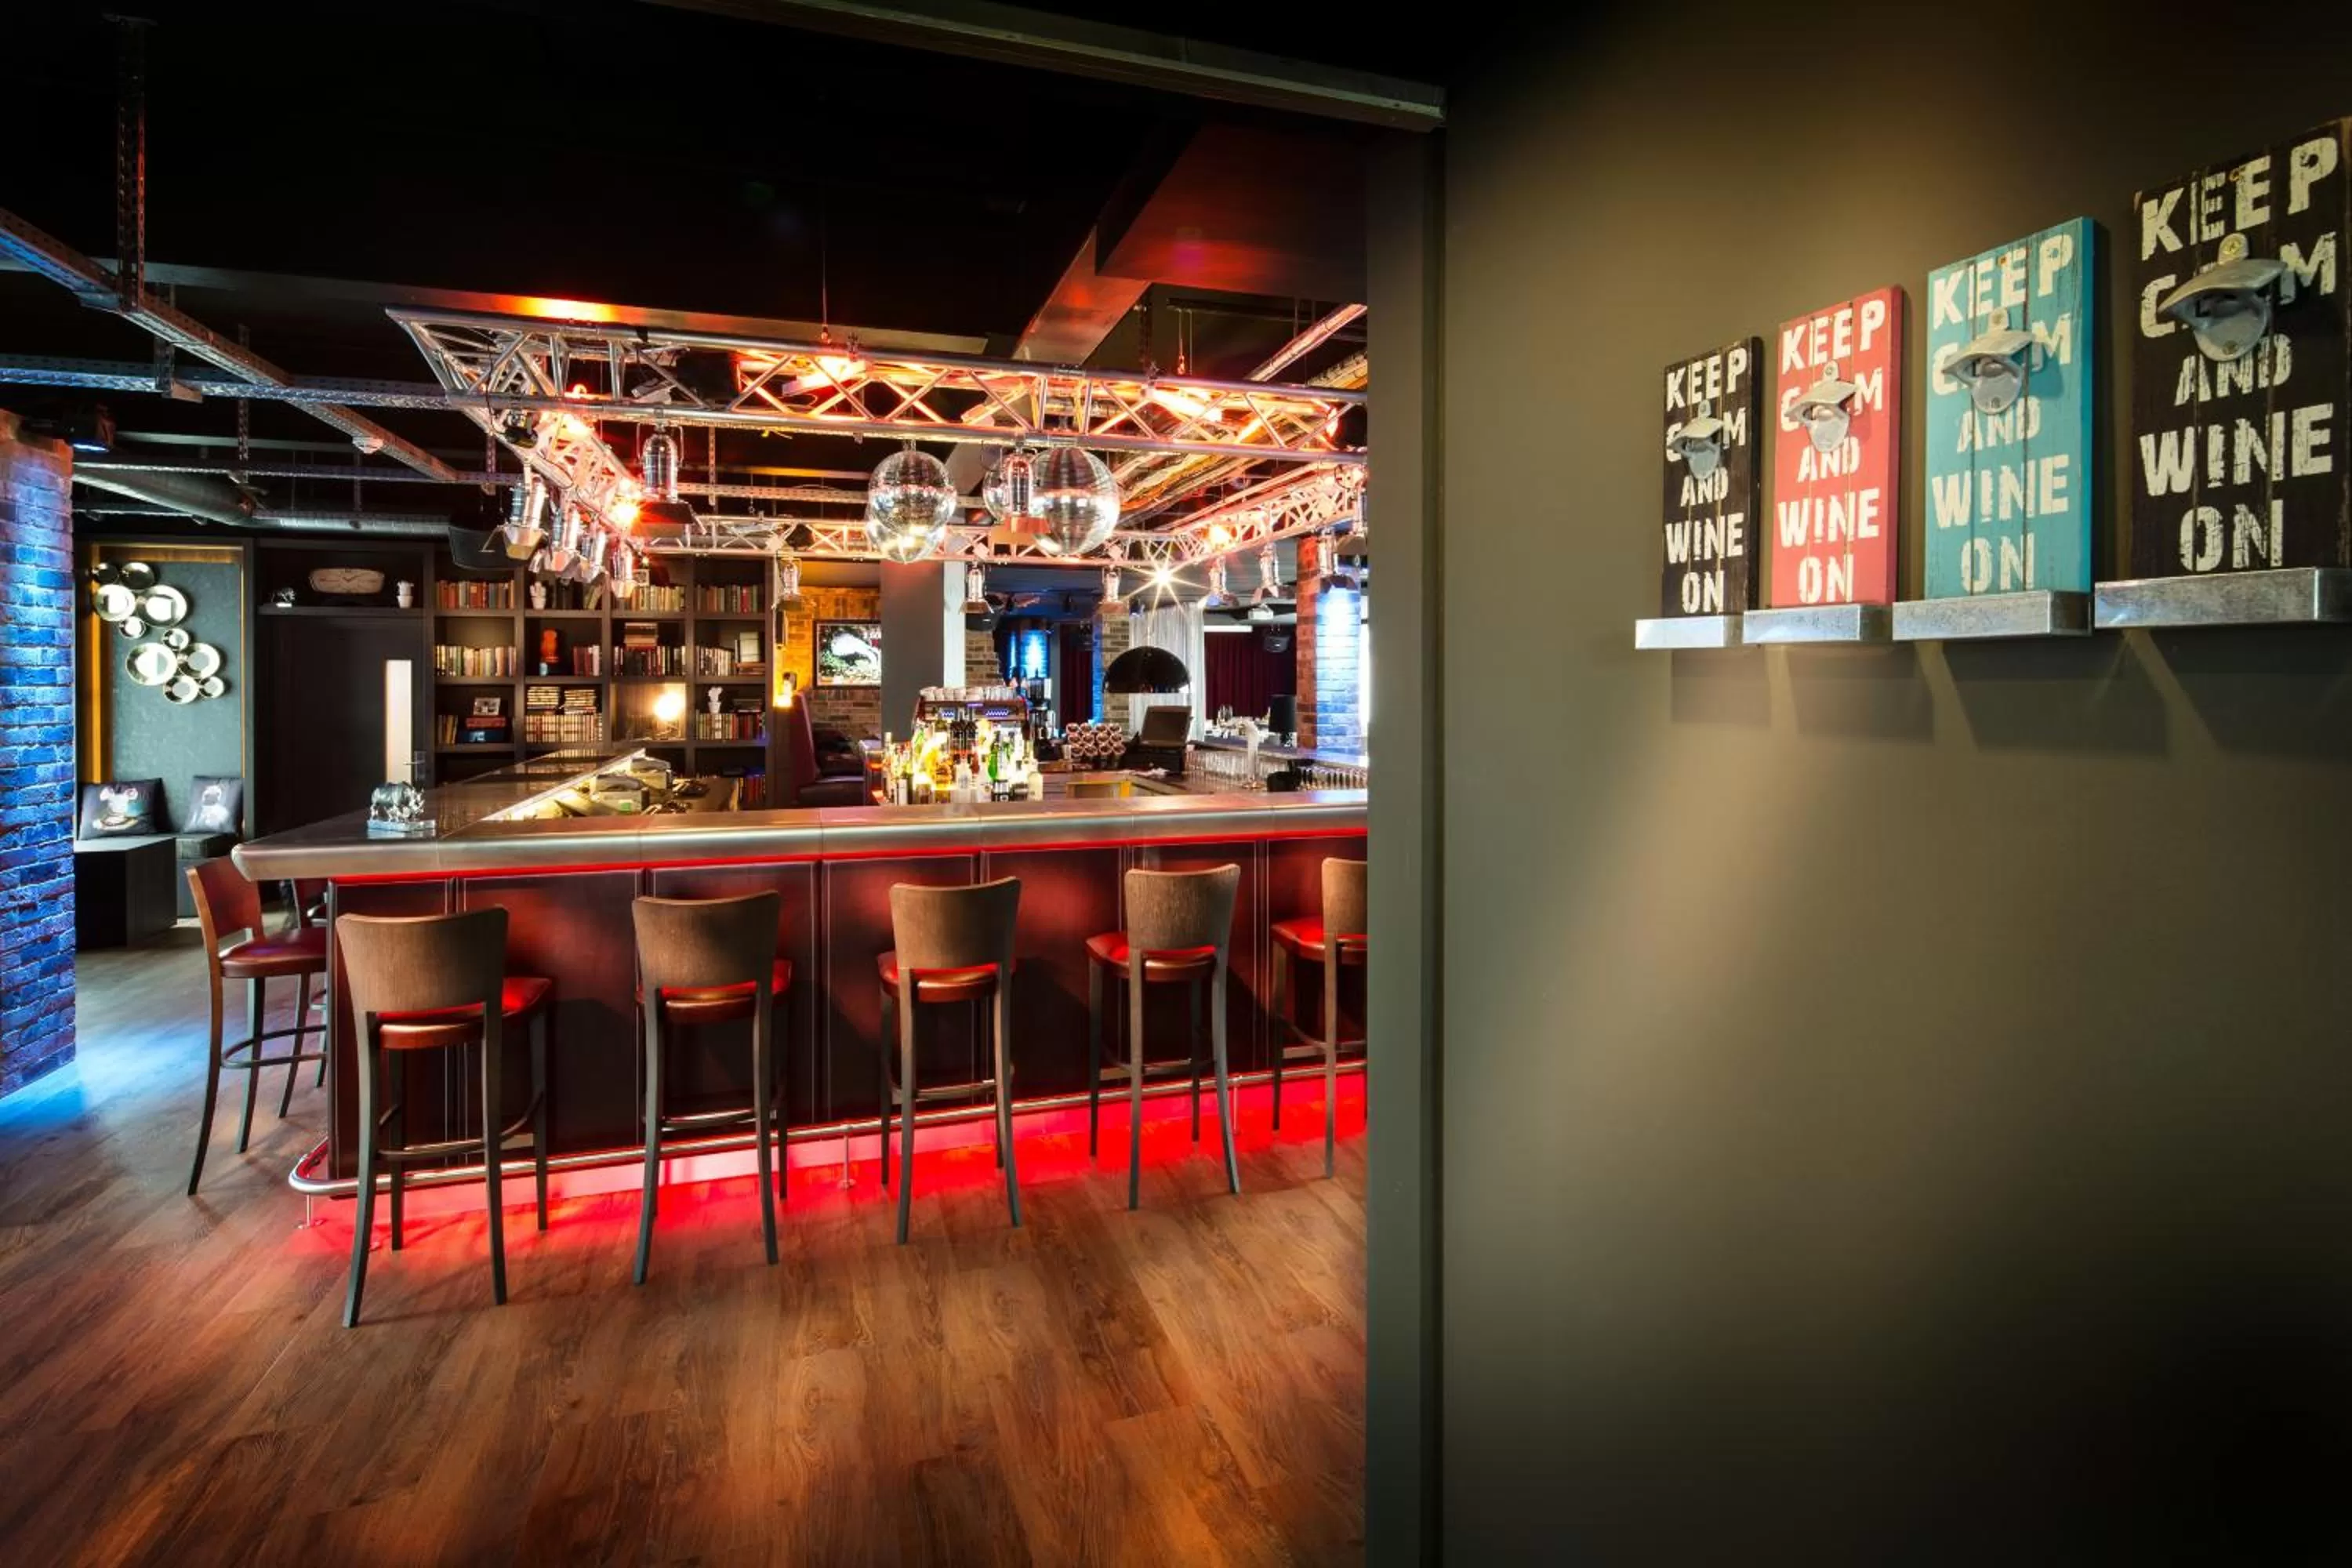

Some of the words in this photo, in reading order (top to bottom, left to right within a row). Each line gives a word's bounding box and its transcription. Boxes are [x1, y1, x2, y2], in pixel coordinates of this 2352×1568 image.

[2141, 136, 2338, 261] KEEP
[1933, 233, 2074, 329] KEEP
[2140, 231, 2336, 338] CM
[1782, 299, 1886, 375] KEEP
[1932, 313, 2071, 395] CM
[1666, 348, 1748, 412] KEEP
[1780, 367, 1882, 432] CM
[2174, 333, 2292, 406] AND
[1666, 407, 1746, 462] CM
[1957, 396, 2041, 452] AND
[2139, 402, 2334, 496] WINE
[1681, 467, 1729, 507] AND
[1798, 437, 1860, 483] AND
[1932, 454, 2069, 529] WINE
[1665, 513, 1744, 564] WINE
[1777, 488, 1879, 547] WINE
[2180, 499, 2285, 572] ON
[1682, 571, 1725, 615] ON
[1798, 554, 1854, 604] ON
[1961, 532, 2034, 593] ON
